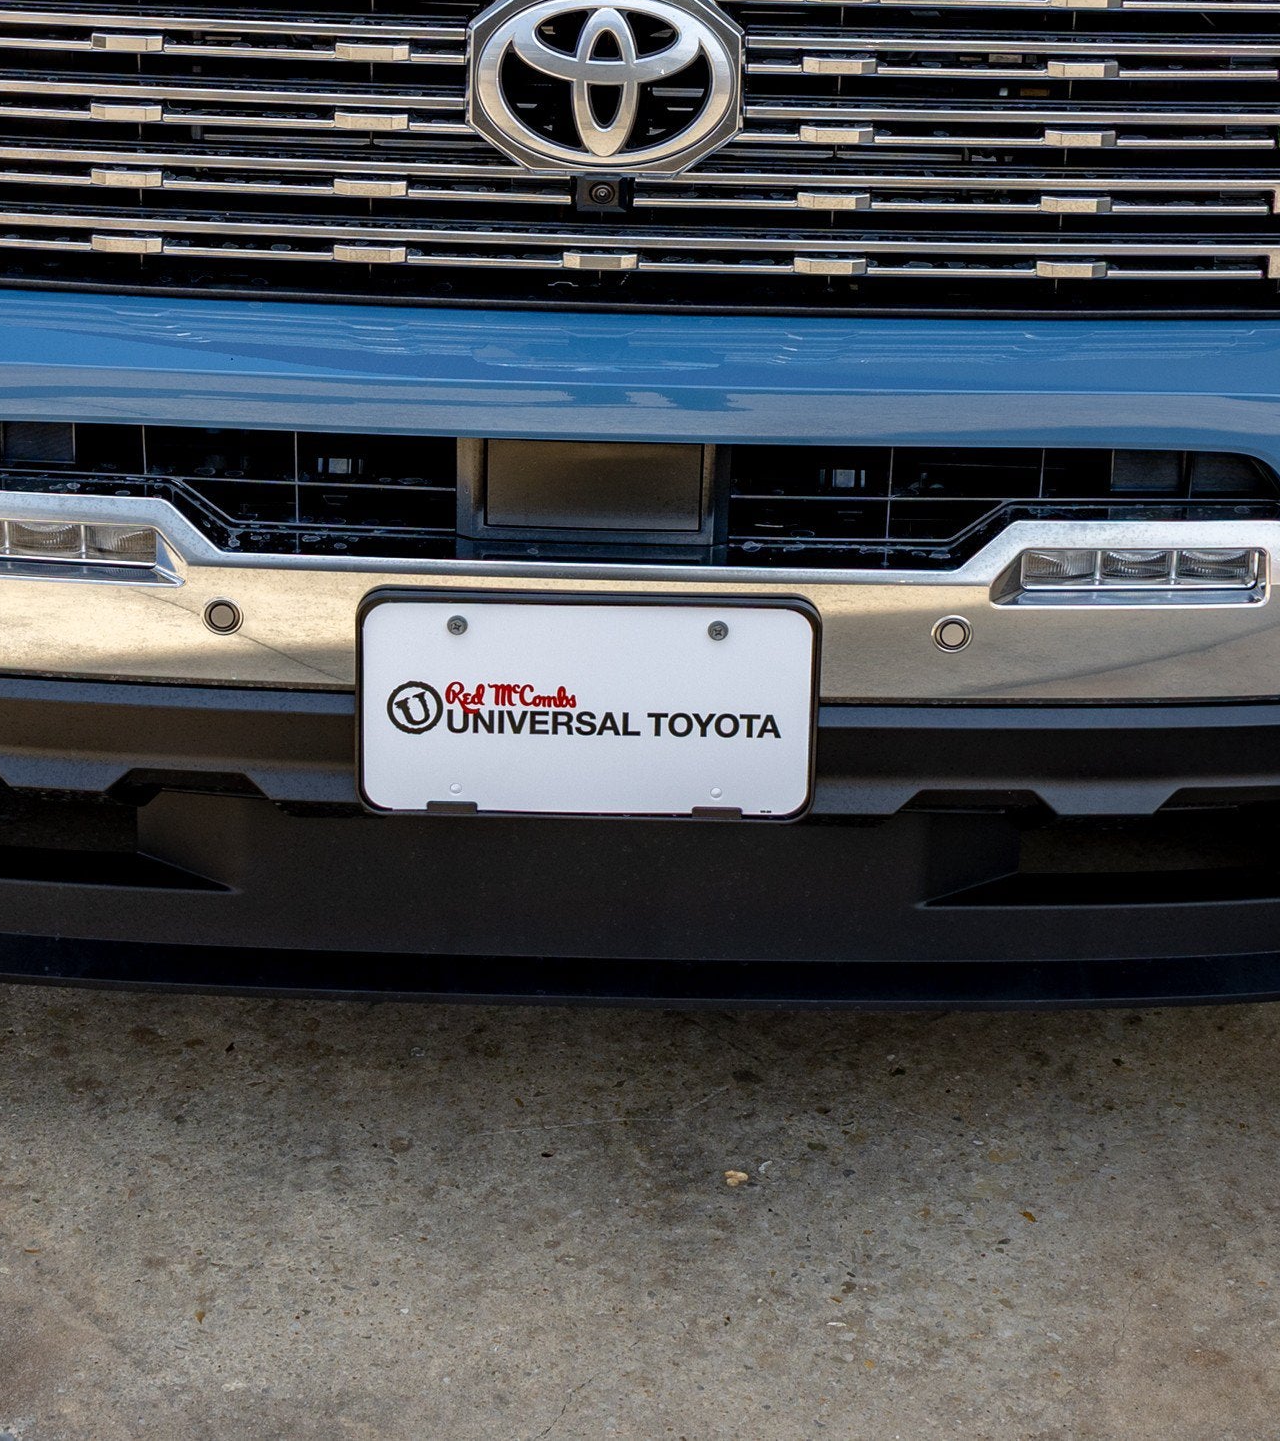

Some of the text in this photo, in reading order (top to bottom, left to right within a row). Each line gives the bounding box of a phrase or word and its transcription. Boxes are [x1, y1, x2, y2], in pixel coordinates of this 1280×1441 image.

[445, 681, 577, 715] Red McCombs
[446, 709, 782, 739] UNIVERSAL TOYOTA
